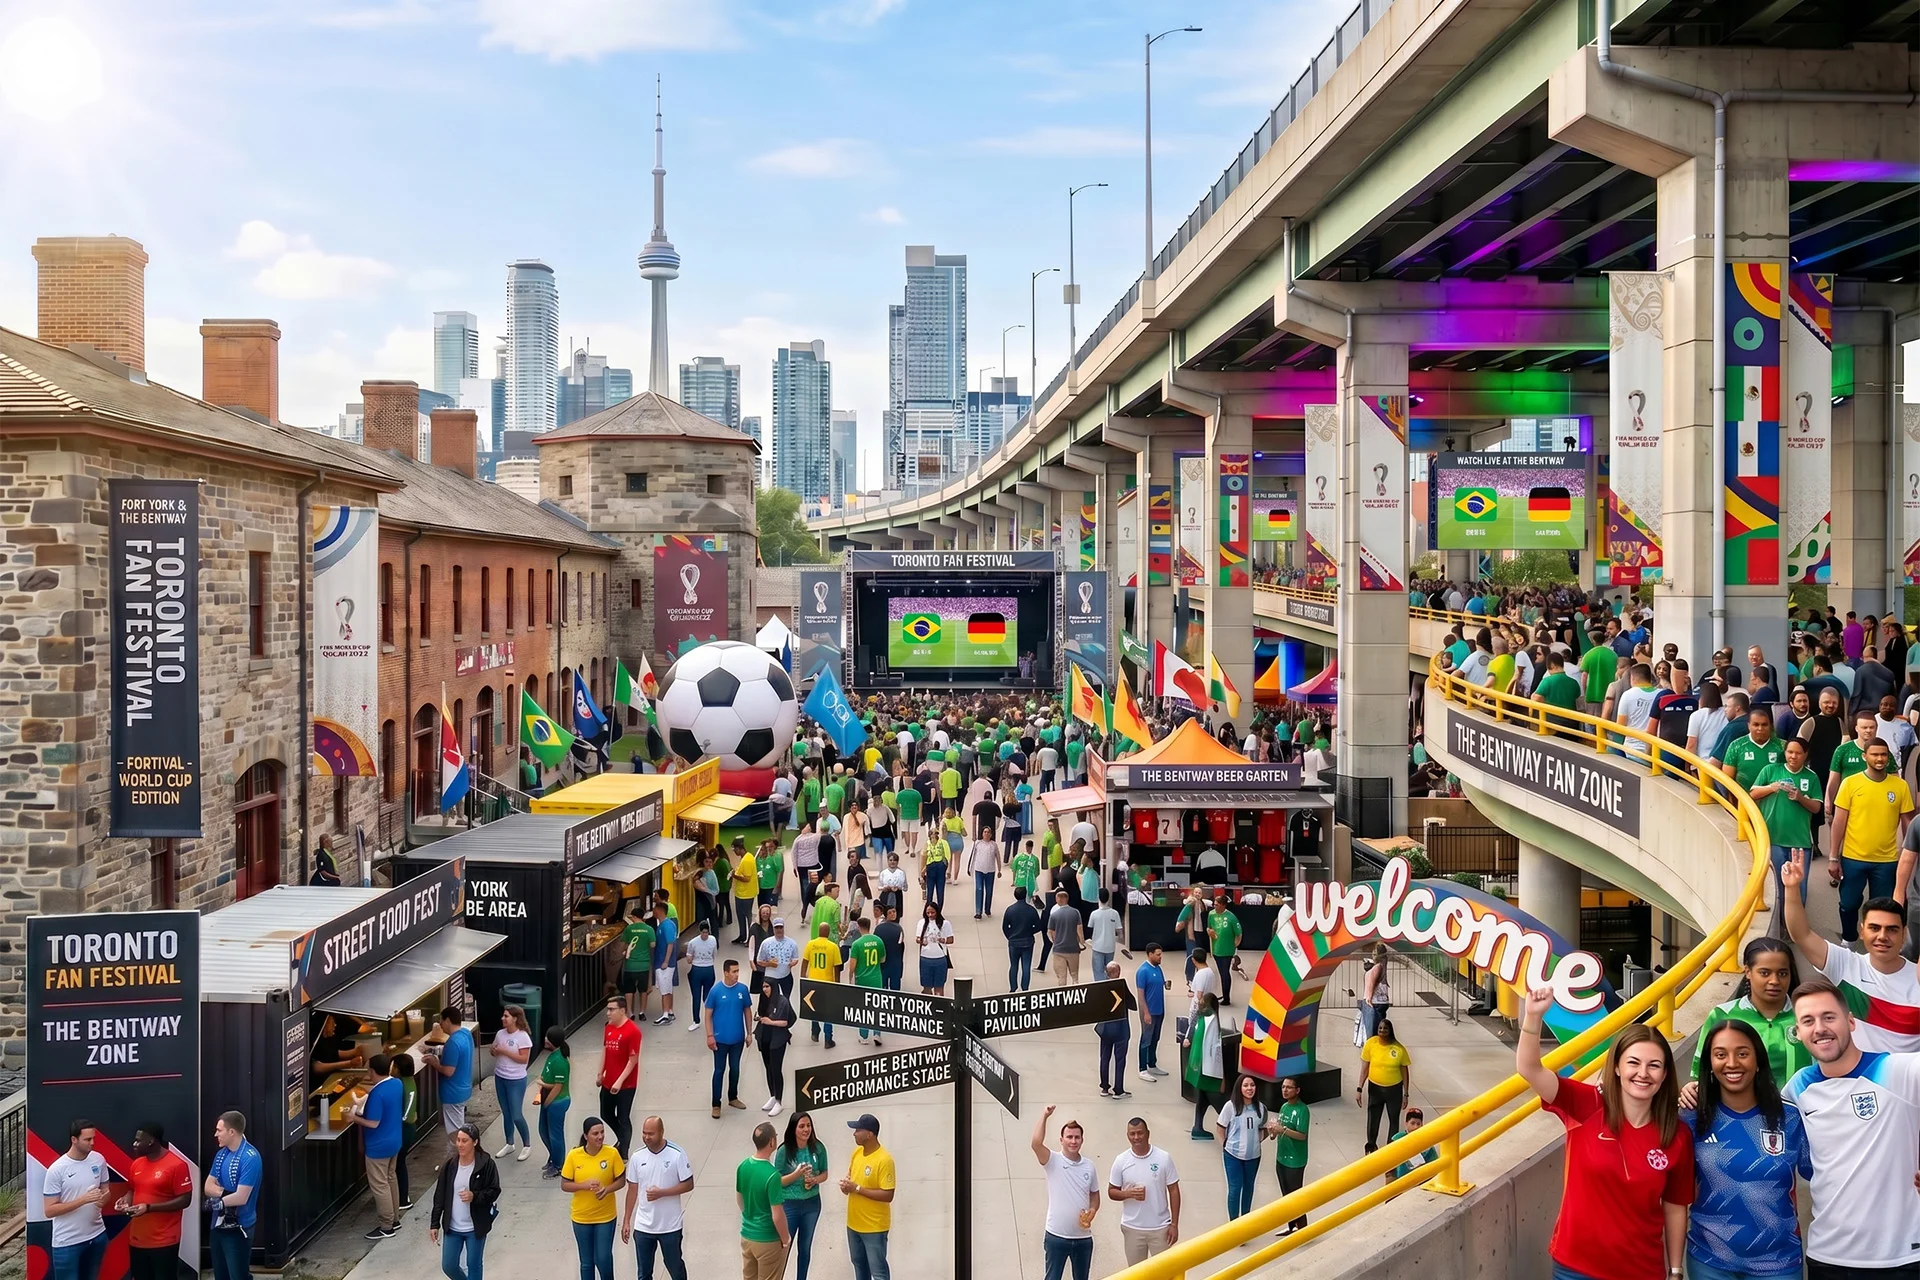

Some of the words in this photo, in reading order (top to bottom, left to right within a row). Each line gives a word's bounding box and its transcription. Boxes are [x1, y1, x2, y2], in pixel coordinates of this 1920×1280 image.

[1457, 456, 1482, 465] WATCH
[1484, 456, 1500, 465] LIVE
[1502, 456, 1512, 465] AT
[1513, 456, 1528, 465] THE
[121, 498, 146, 510] FORT
[148, 499, 175, 511] YORK
[178, 499, 187, 512] &
[120, 512, 139, 524] THE
[142, 513, 187, 524] BENTWAY
[126, 540, 152, 592] FAN
[892, 554, 940, 567] TORONTO
[966, 554, 1016, 567] FESTIVAL
[156, 538, 186, 684] TORONTO
[126, 602, 153, 727] FESTIVAL
[127, 756, 184, 770] FORTIVAL
[1455, 722, 1476, 758] THE
[1480, 732, 1542, 784] BENTWAY
[1546, 754, 1575, 797] FAN
[1579, 766, 1623, 818] ZONE
[119, 774, 162, 787] WORLD
[167, 774, 192, 787] CUP
[1142, 770, 1162, 782] THE
[1164, 770, 1214, 782] BENTWAY
[1216, 770, 1244, 782] BEER
[1246, 770, 1288, 782] GARTEN
[470, 880, 508, 898] YORK
[488, 901, 528, 918] AREA
[324, 915, 376, 976] STREET
[378, 898, 410, 945] FOOD
[413, 882, 442, 926] FEST
[1295, 856, 1605, 1014] welcome
[46, 930, 178, 964] TORONTO
[814, 952, 826, 970] 10
[46, 967, 83, 990] FAN
[90, 963, 181, 988] FESTIVAL
[864, 992, 896, 1010] FORT
[900, 996, 932, 1016] YORK
[984, 999, 998, 1016] TO
[1002, 996, 1026, 1013] THE
[1030, 988, 1088, 1010] BENTWAY
[43, 1020, 81, 1042] THE
[88, 1015, 182, 1040] BENTWAY
[844, 1006, 874, 1025] MAIN
[879, 1010, 944, 1036] ENTRANCE
[984, 1012, 1041, 1034] PAVILION
[86, 1042, 140, 1066] ZONE
[844, 1063, 860, 1080] TO
[864, 1057, 888, 1075] THE
[892, 1046, 951, 1071] BENTWAY
[814, 1072, 909, 1105] PERFORMANCE
[912, 1064, 952, 1085] STAGE
